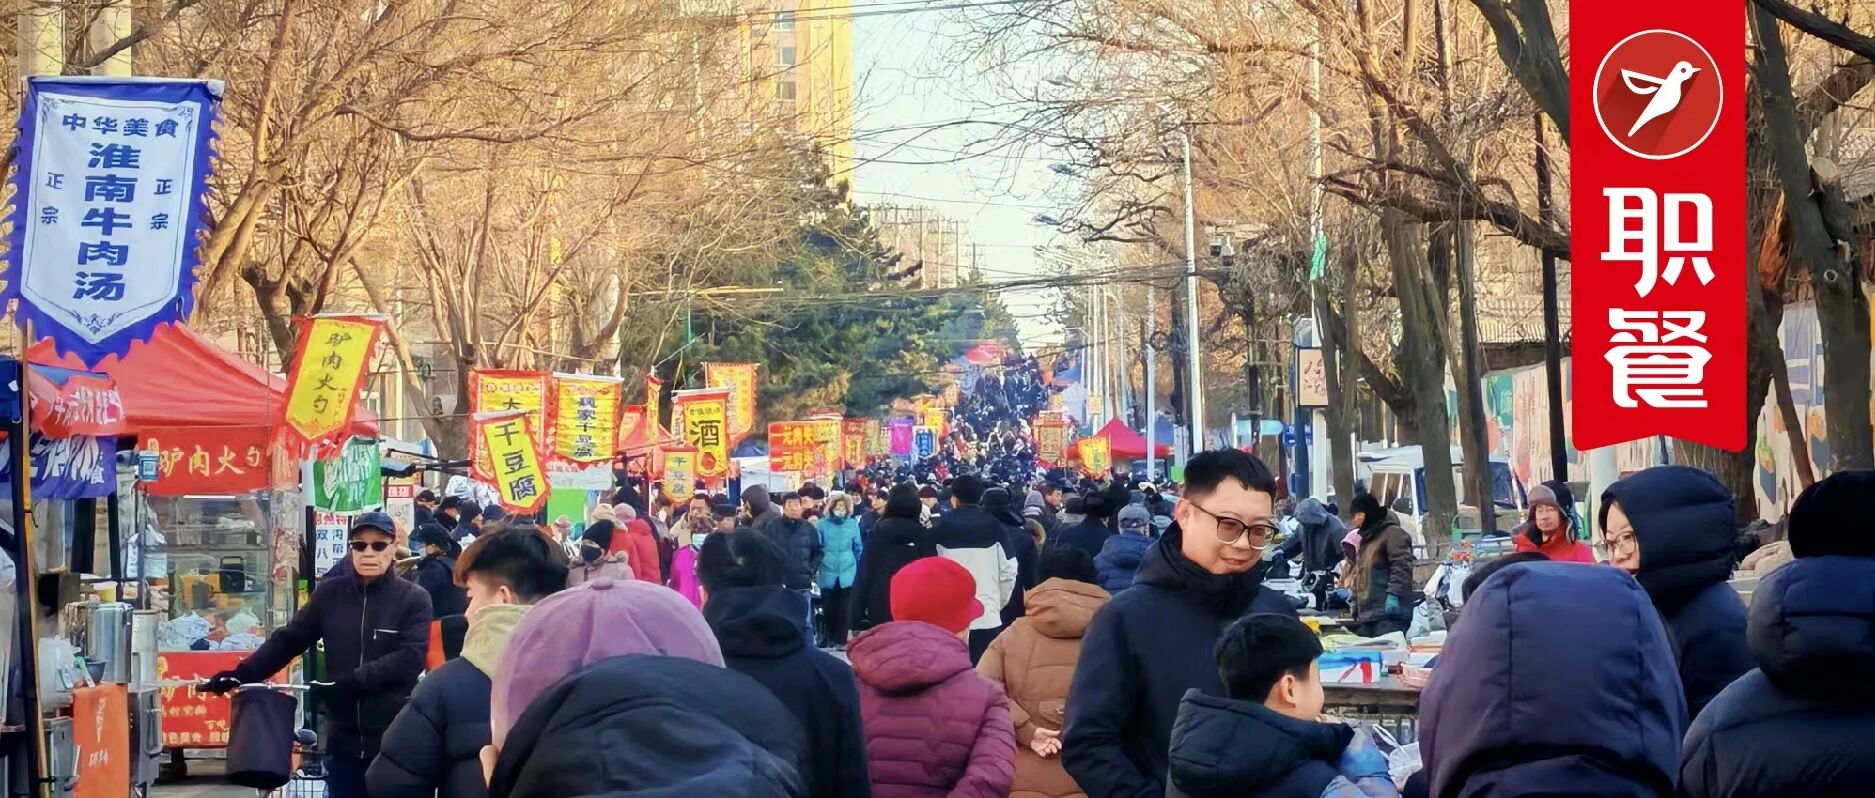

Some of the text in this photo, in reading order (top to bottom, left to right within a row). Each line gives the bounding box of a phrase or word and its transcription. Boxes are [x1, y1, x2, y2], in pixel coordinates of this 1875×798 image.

[62, 113, 179, 138] 中华美食
[41, 172, 65, 225] 正宗
[72, 143, 141, 301] 淮南牛肉汤
[150, 178, 173, 231] 正宗
[312, 332, 352, 414] 驴肉火勺
[689, 419, 721, 448] 酒
[494, 421, 537, 502] 干豆腐
